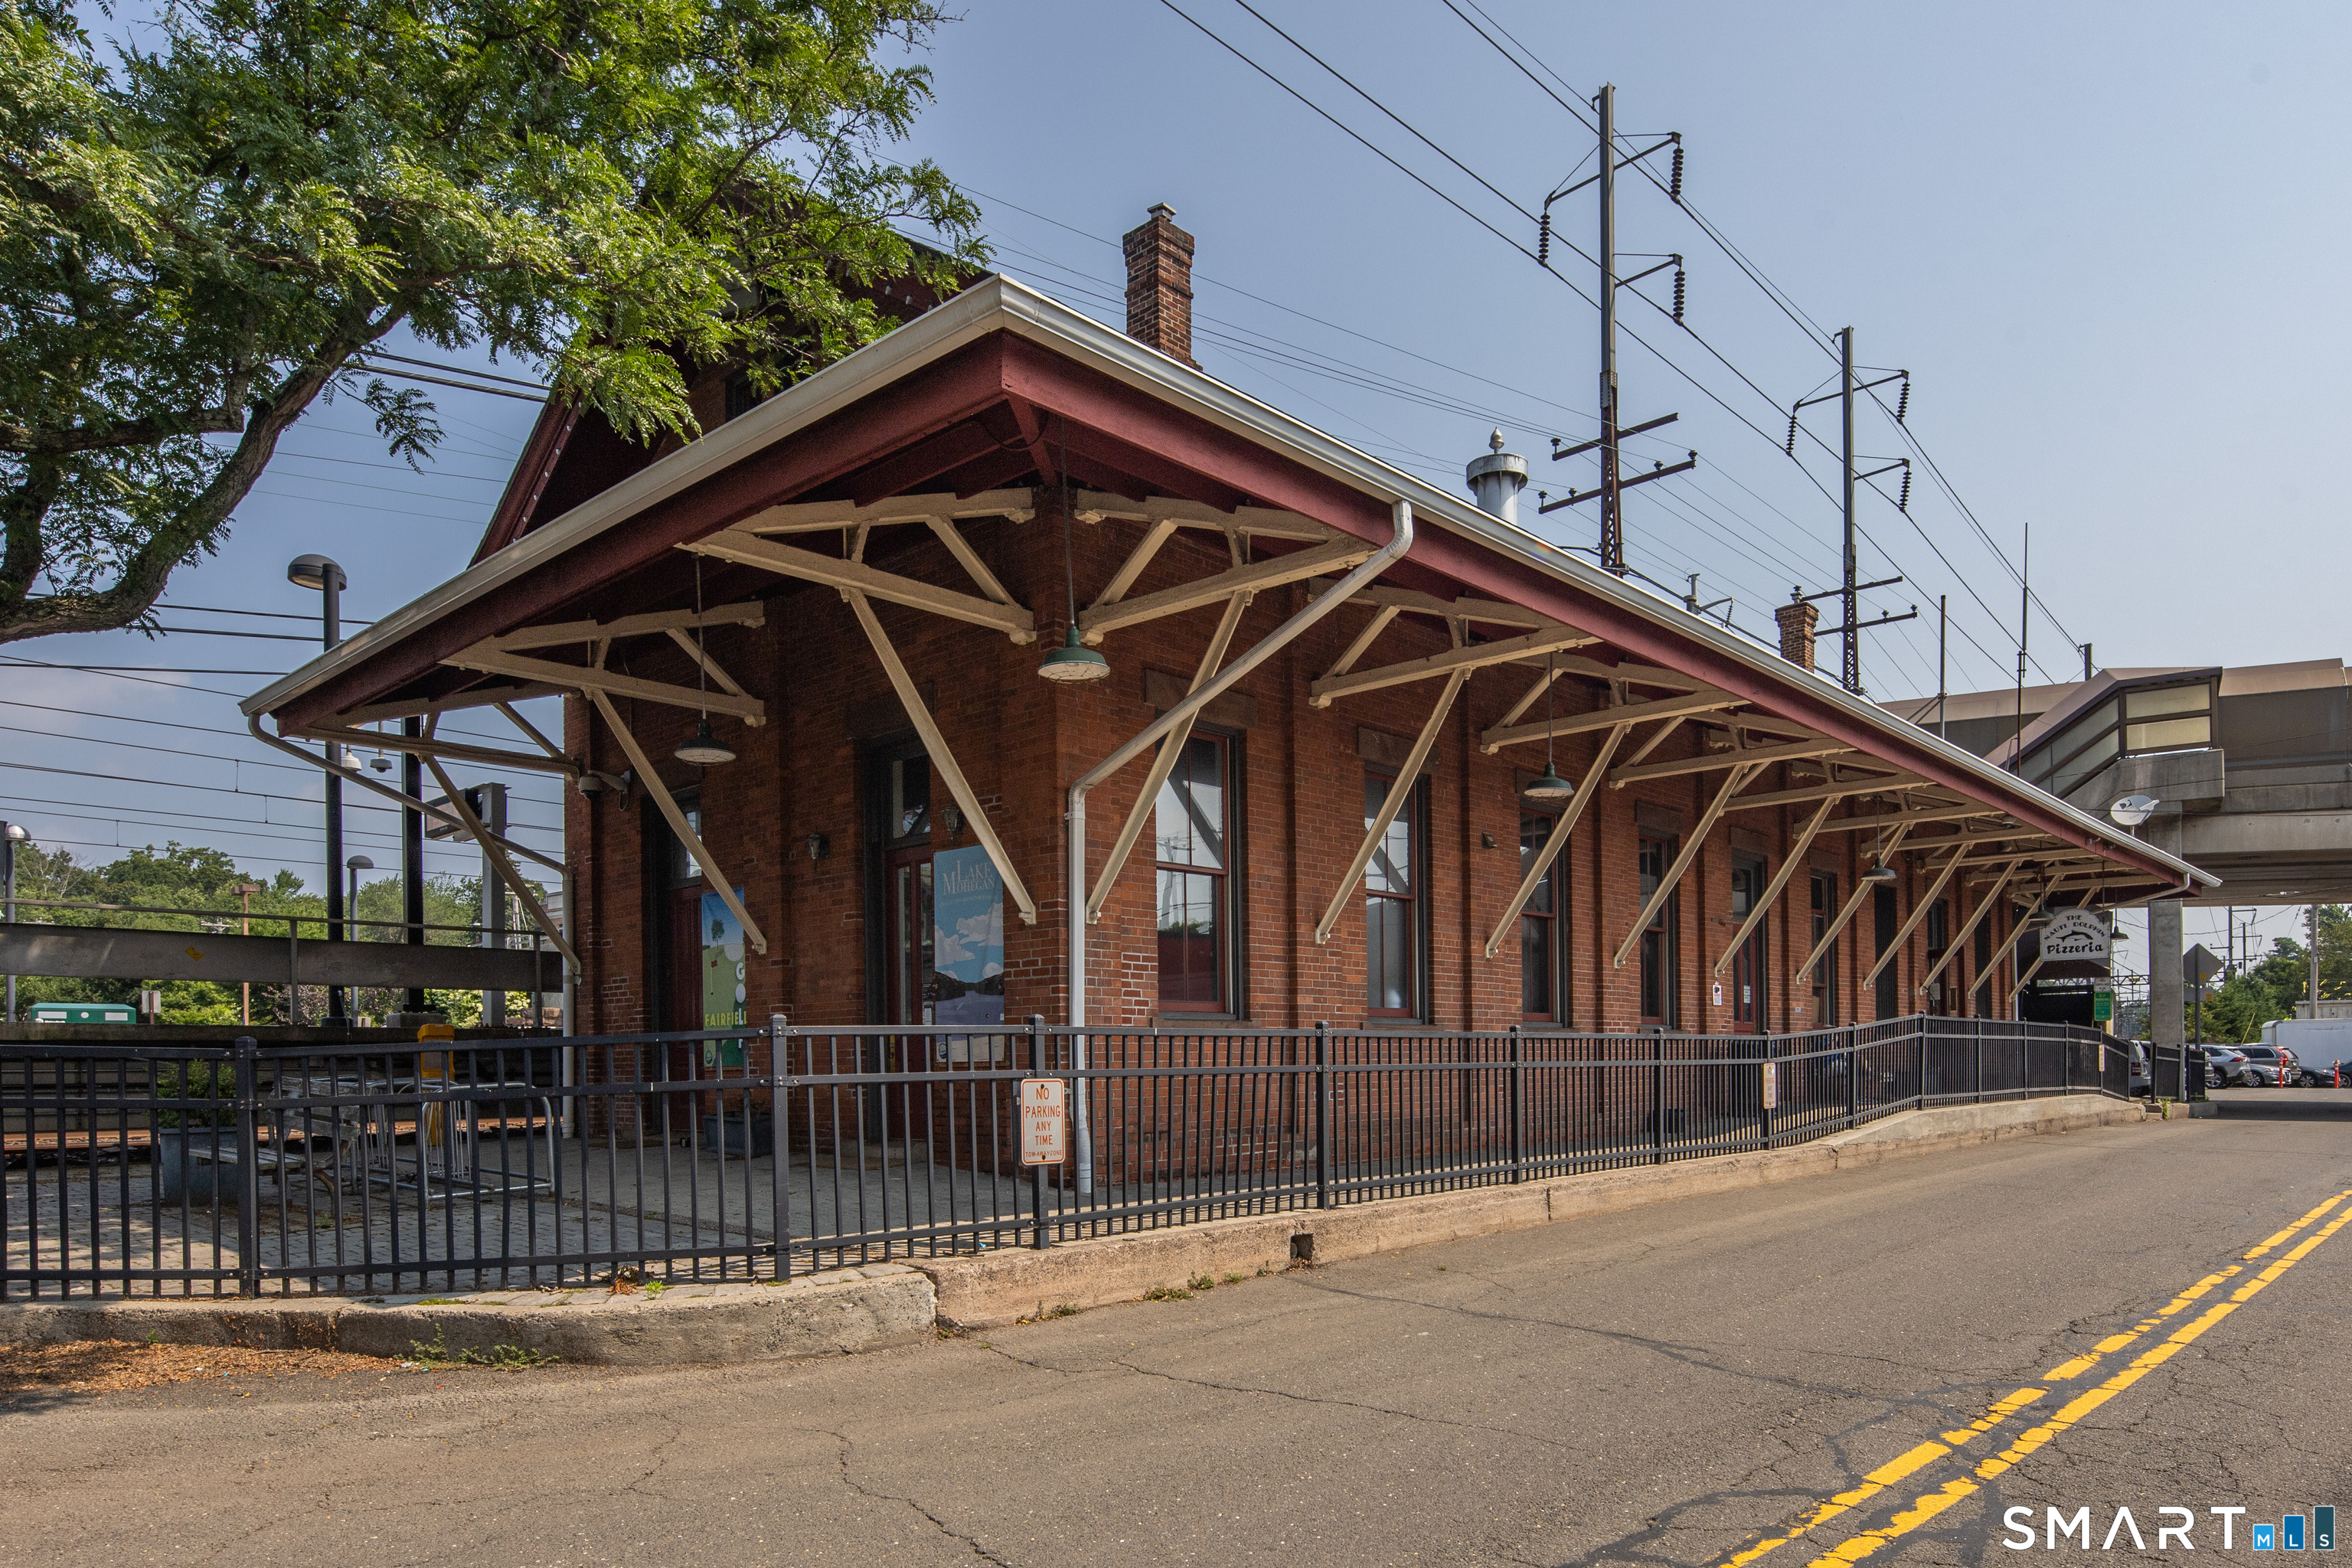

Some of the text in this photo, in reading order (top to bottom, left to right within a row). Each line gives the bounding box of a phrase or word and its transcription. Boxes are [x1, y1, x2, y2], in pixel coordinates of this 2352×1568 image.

[2043, 922, 2106, 941] NAUTI DOLPHIN
[2047, 942, 2104, 955] Pizzeria
[1036, 1087, 1050, 1100] NO
[1025, 1105, 1060, 1119] PARKING
[1035, 1120, 1052, 1132] ANY
[1034, 1134, 1053, 1146] TIME
